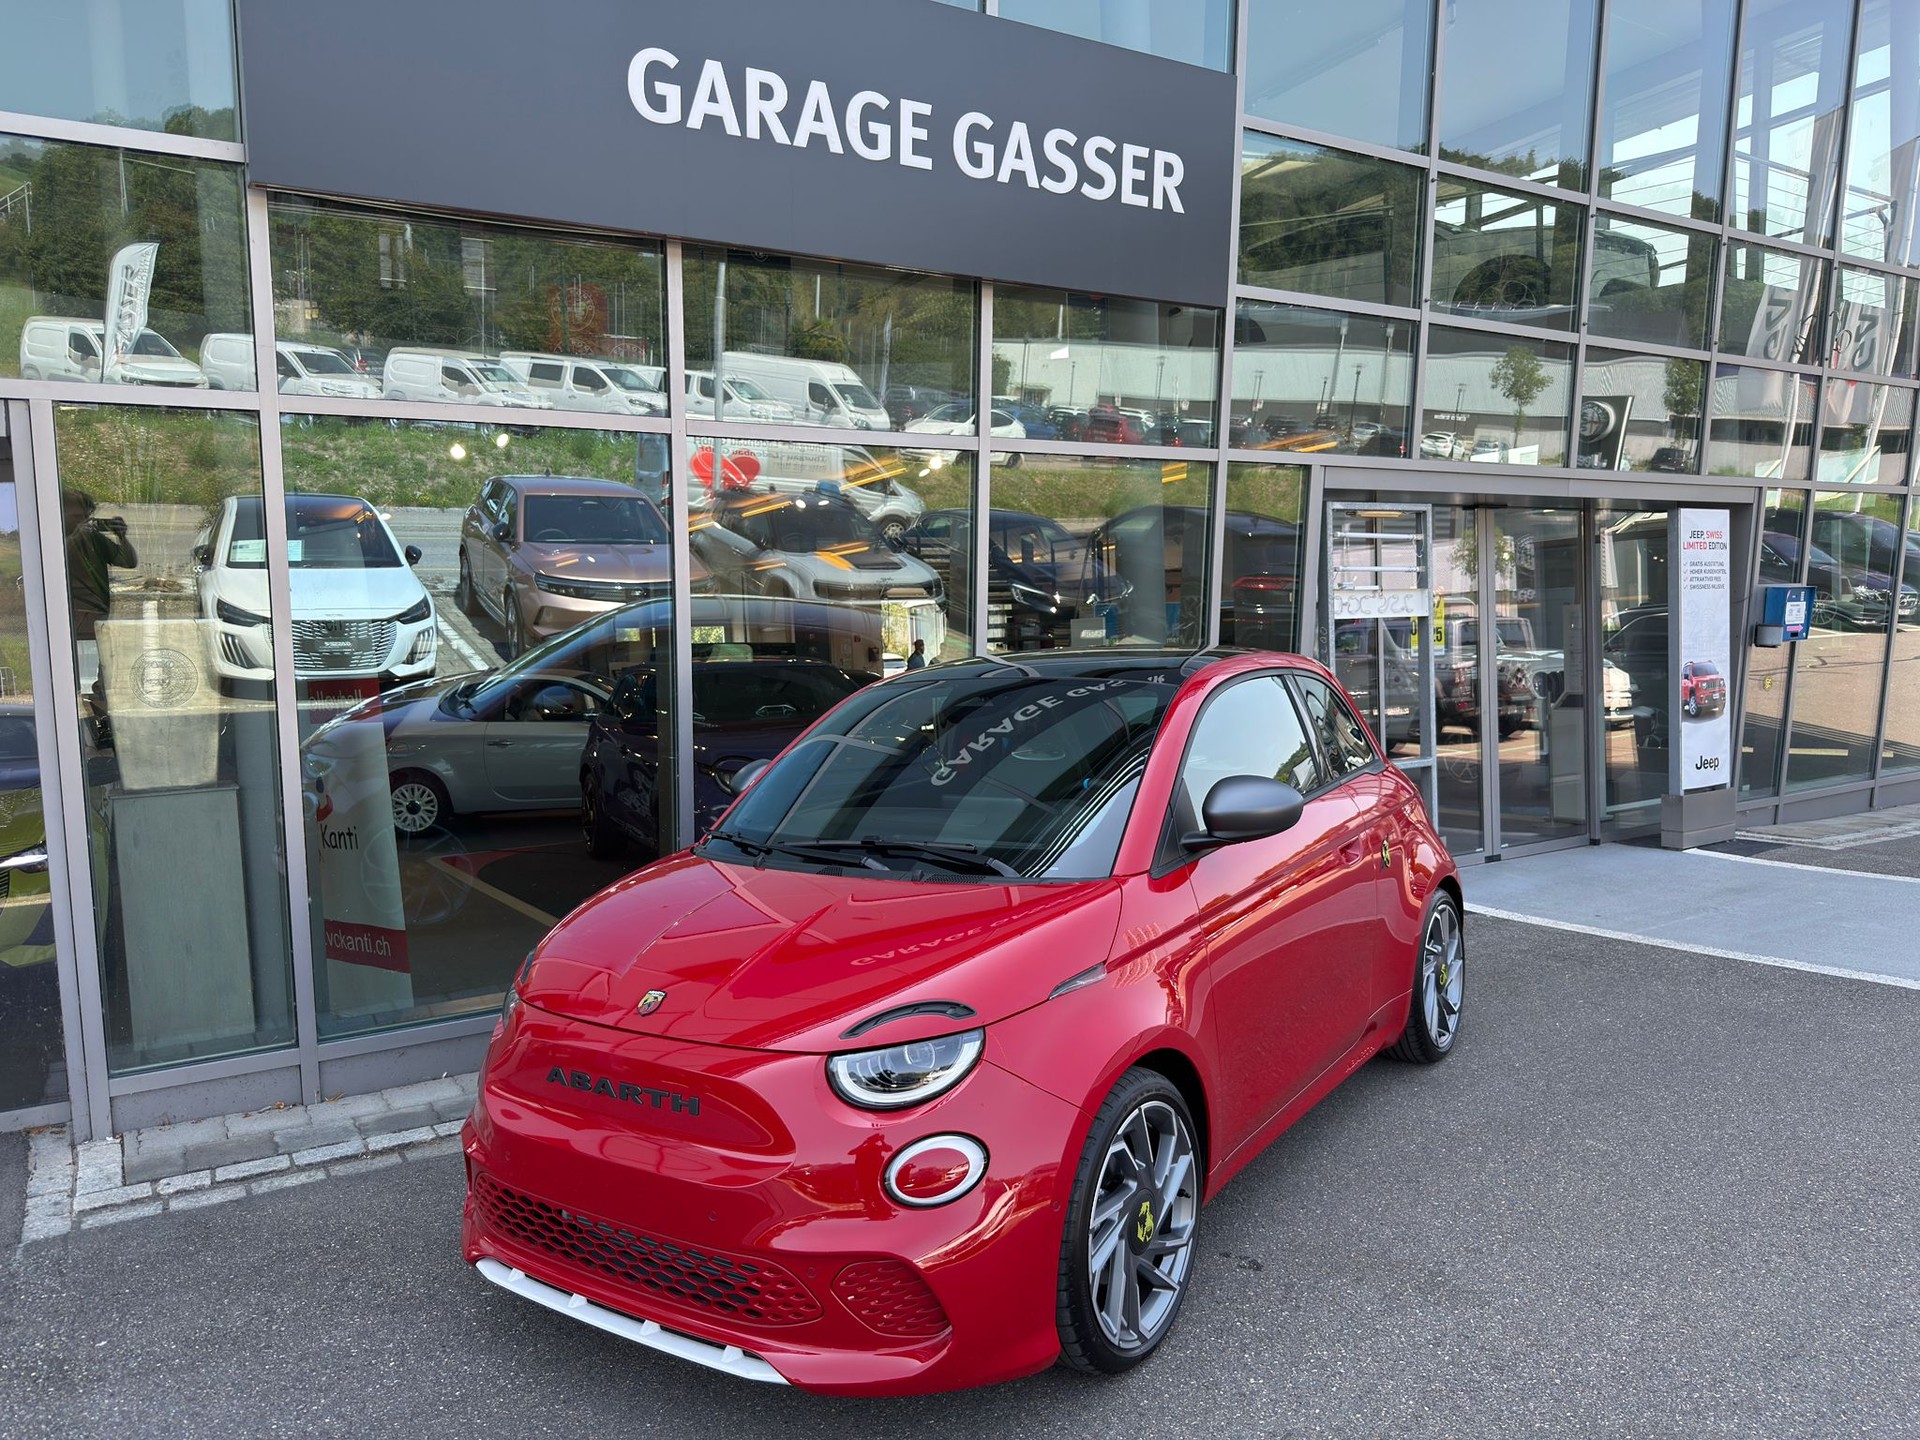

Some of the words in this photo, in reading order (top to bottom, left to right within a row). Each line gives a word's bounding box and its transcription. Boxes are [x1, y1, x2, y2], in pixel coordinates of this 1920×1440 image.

[627, 47, 933, 170] GARAGE
[953, 112, 1185, 214] GASSER
[1706, 530, 1723, 539] SWISS
[1683, 541, 1707, 550] LIMITED
[1695, 755, 1720, 771] Jeep
[320, 824, 359, 850] Kanti
[546, 1065, 700, 1116] ABARTH
